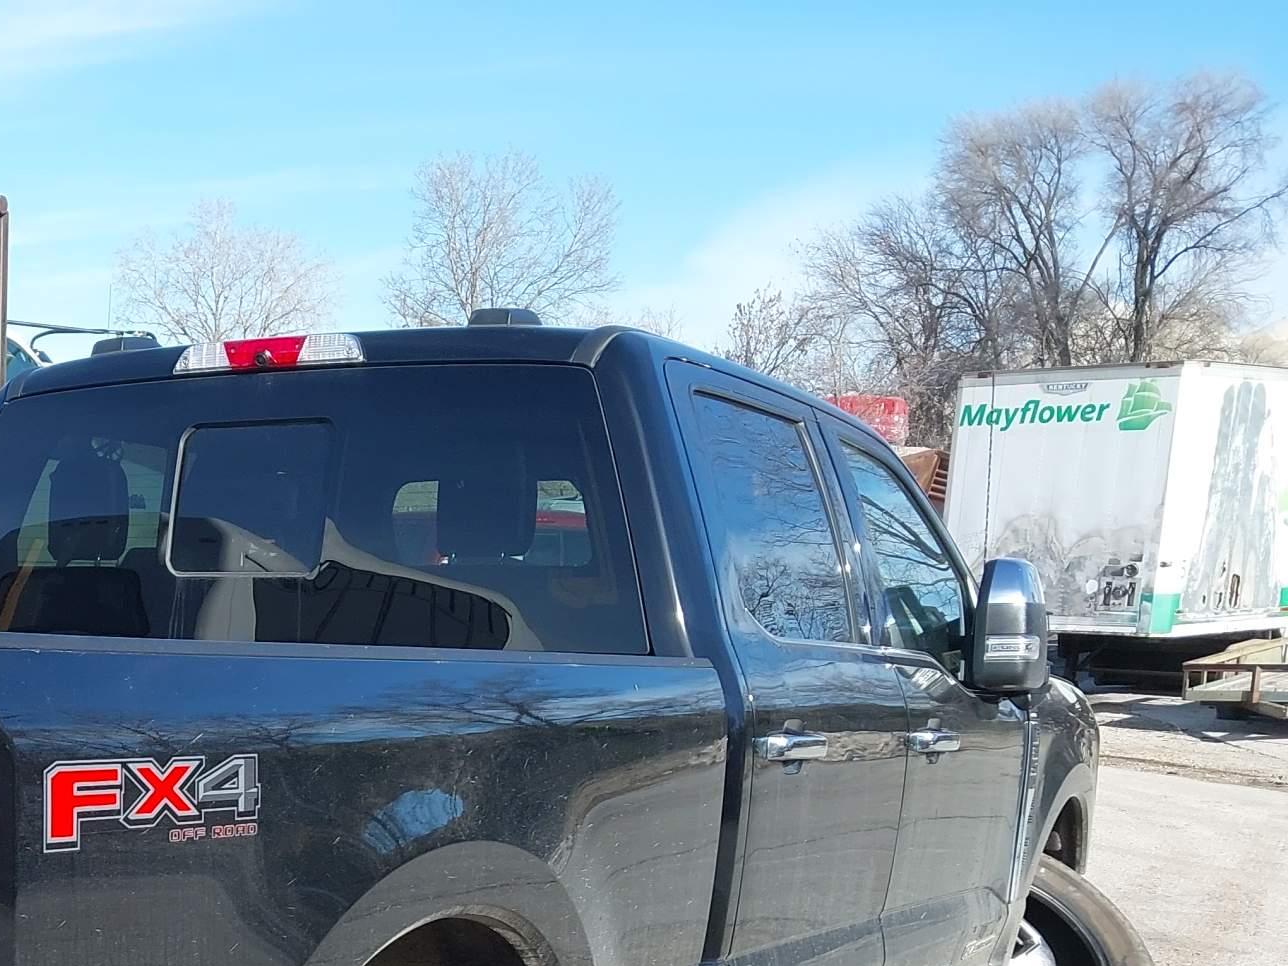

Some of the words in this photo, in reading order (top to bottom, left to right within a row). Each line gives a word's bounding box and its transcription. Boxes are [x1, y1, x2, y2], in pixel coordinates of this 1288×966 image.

[959, 399, 1111, 432] Mayflower
[43, 753, 261, 853] FX4
[168, 826, 207, 843] OFF
[211, 822, 258, 839] ROAD
